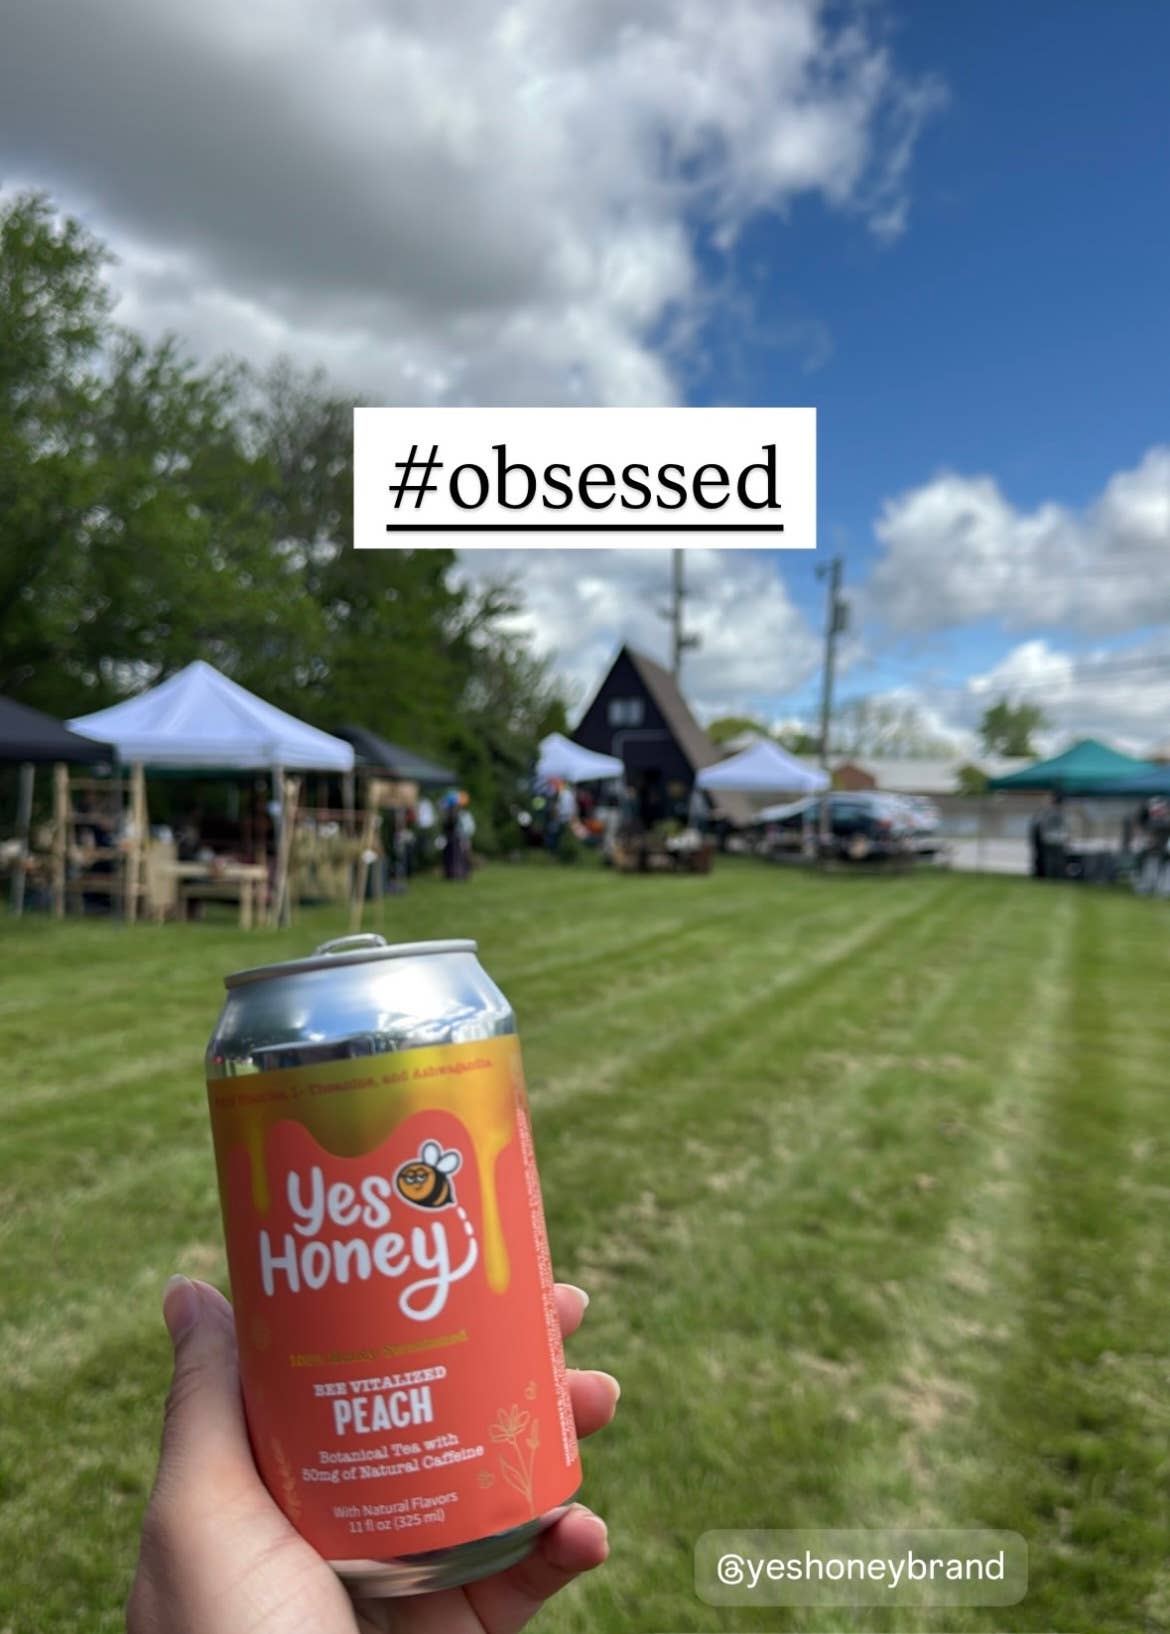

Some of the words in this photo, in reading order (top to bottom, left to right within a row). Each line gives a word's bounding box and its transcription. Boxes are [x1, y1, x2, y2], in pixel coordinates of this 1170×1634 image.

[259, 1221, 479, 1321] Honey
[313, 1382, 347, 1397] BEE
[350, 1365, 447, 1394] VITALIZED
[333, 1386, 434, 1436] PEACH
[319, 1446, 389, 1465] Botanical
[391, 1442, 421, 1455] Tea
[424, 1433, 460, 1450] with
[342, 1467, 356, 1480] of
[360, 1458, 420, 1479] Natural
[422, 1445, 485, 1470] Caffeine
[363, 1499, 410, 1516] Natural
[412, 1492, 458, 1509] Flavors
[350, 1519, 364, 1533] 11
[365, 1517, 375, 1531] fl
[377, 1519, 392, 1531] oz
[394, 1514, 422, 1530] (325
[423, 1510, 445, 1523] ml)
